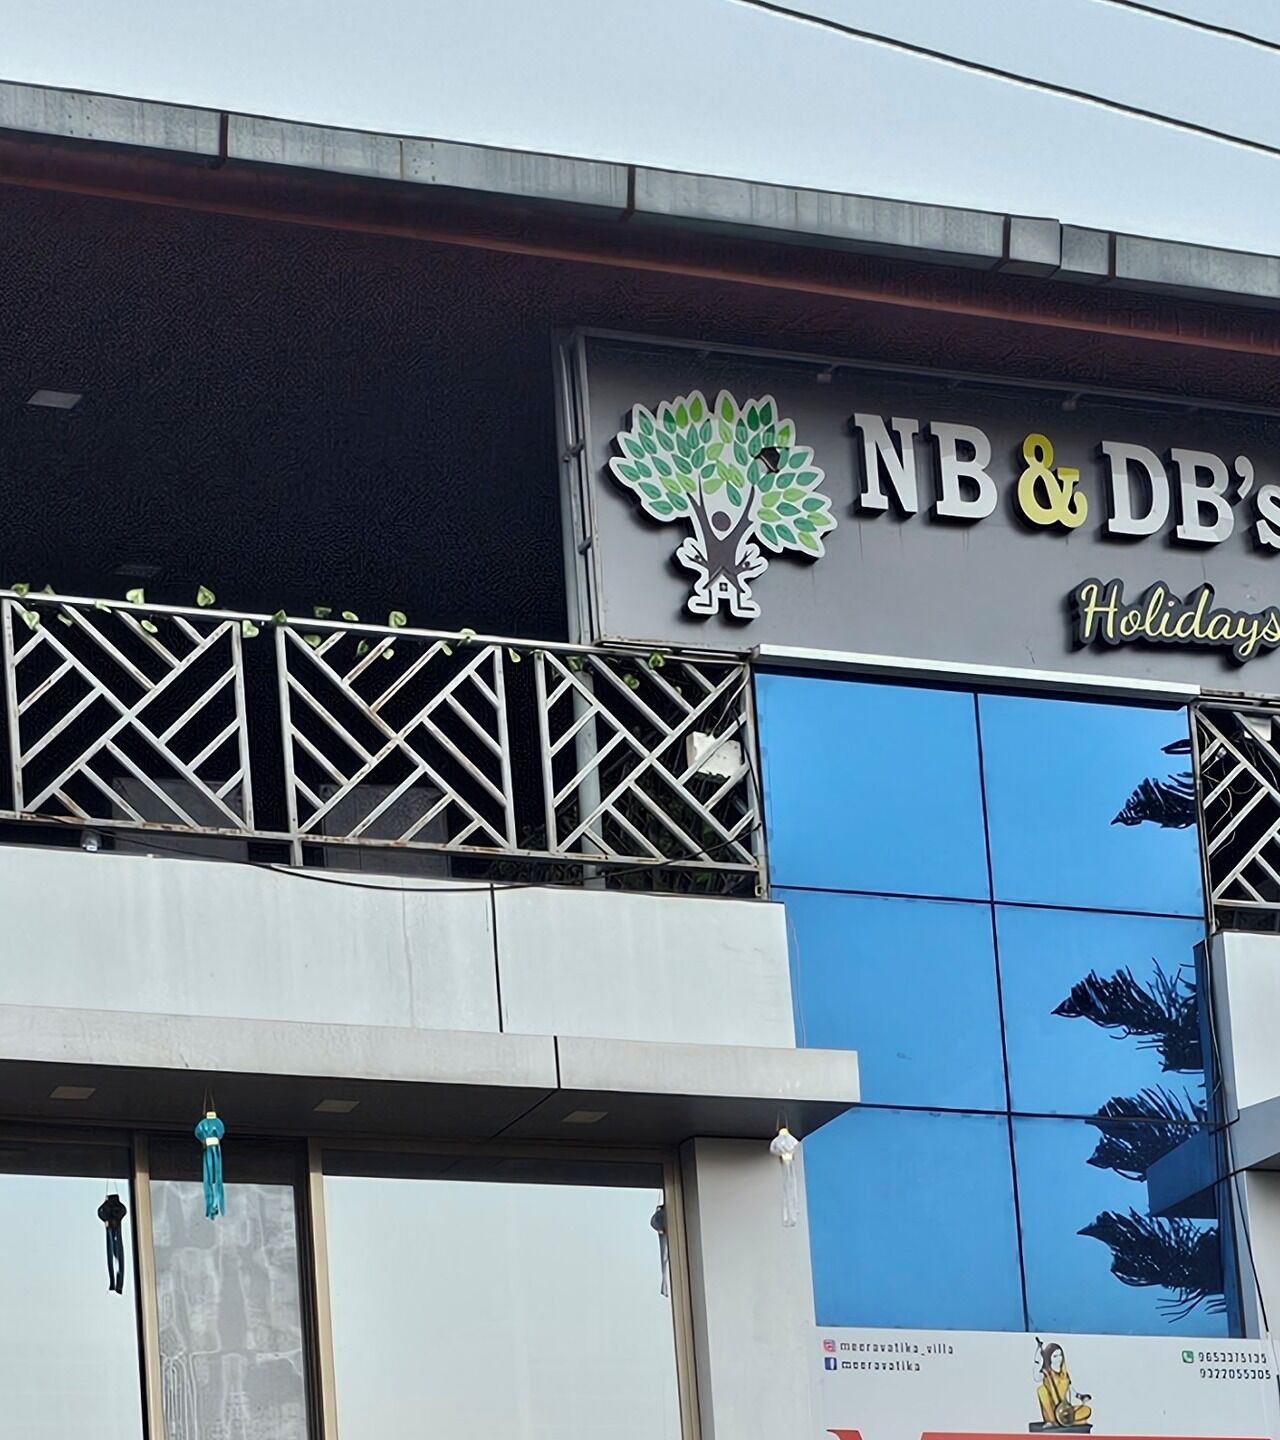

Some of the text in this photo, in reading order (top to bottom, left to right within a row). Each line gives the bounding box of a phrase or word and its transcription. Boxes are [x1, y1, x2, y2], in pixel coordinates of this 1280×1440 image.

[854, 413, 998, 520] NB
[1017, 432, 1089, 529] &
[1198, 1351, 1267, 1364] 9653375135
[841, 1360, 921, 1371] meeravatika
[1199, 1368, 1272, 1379] 9322055305
